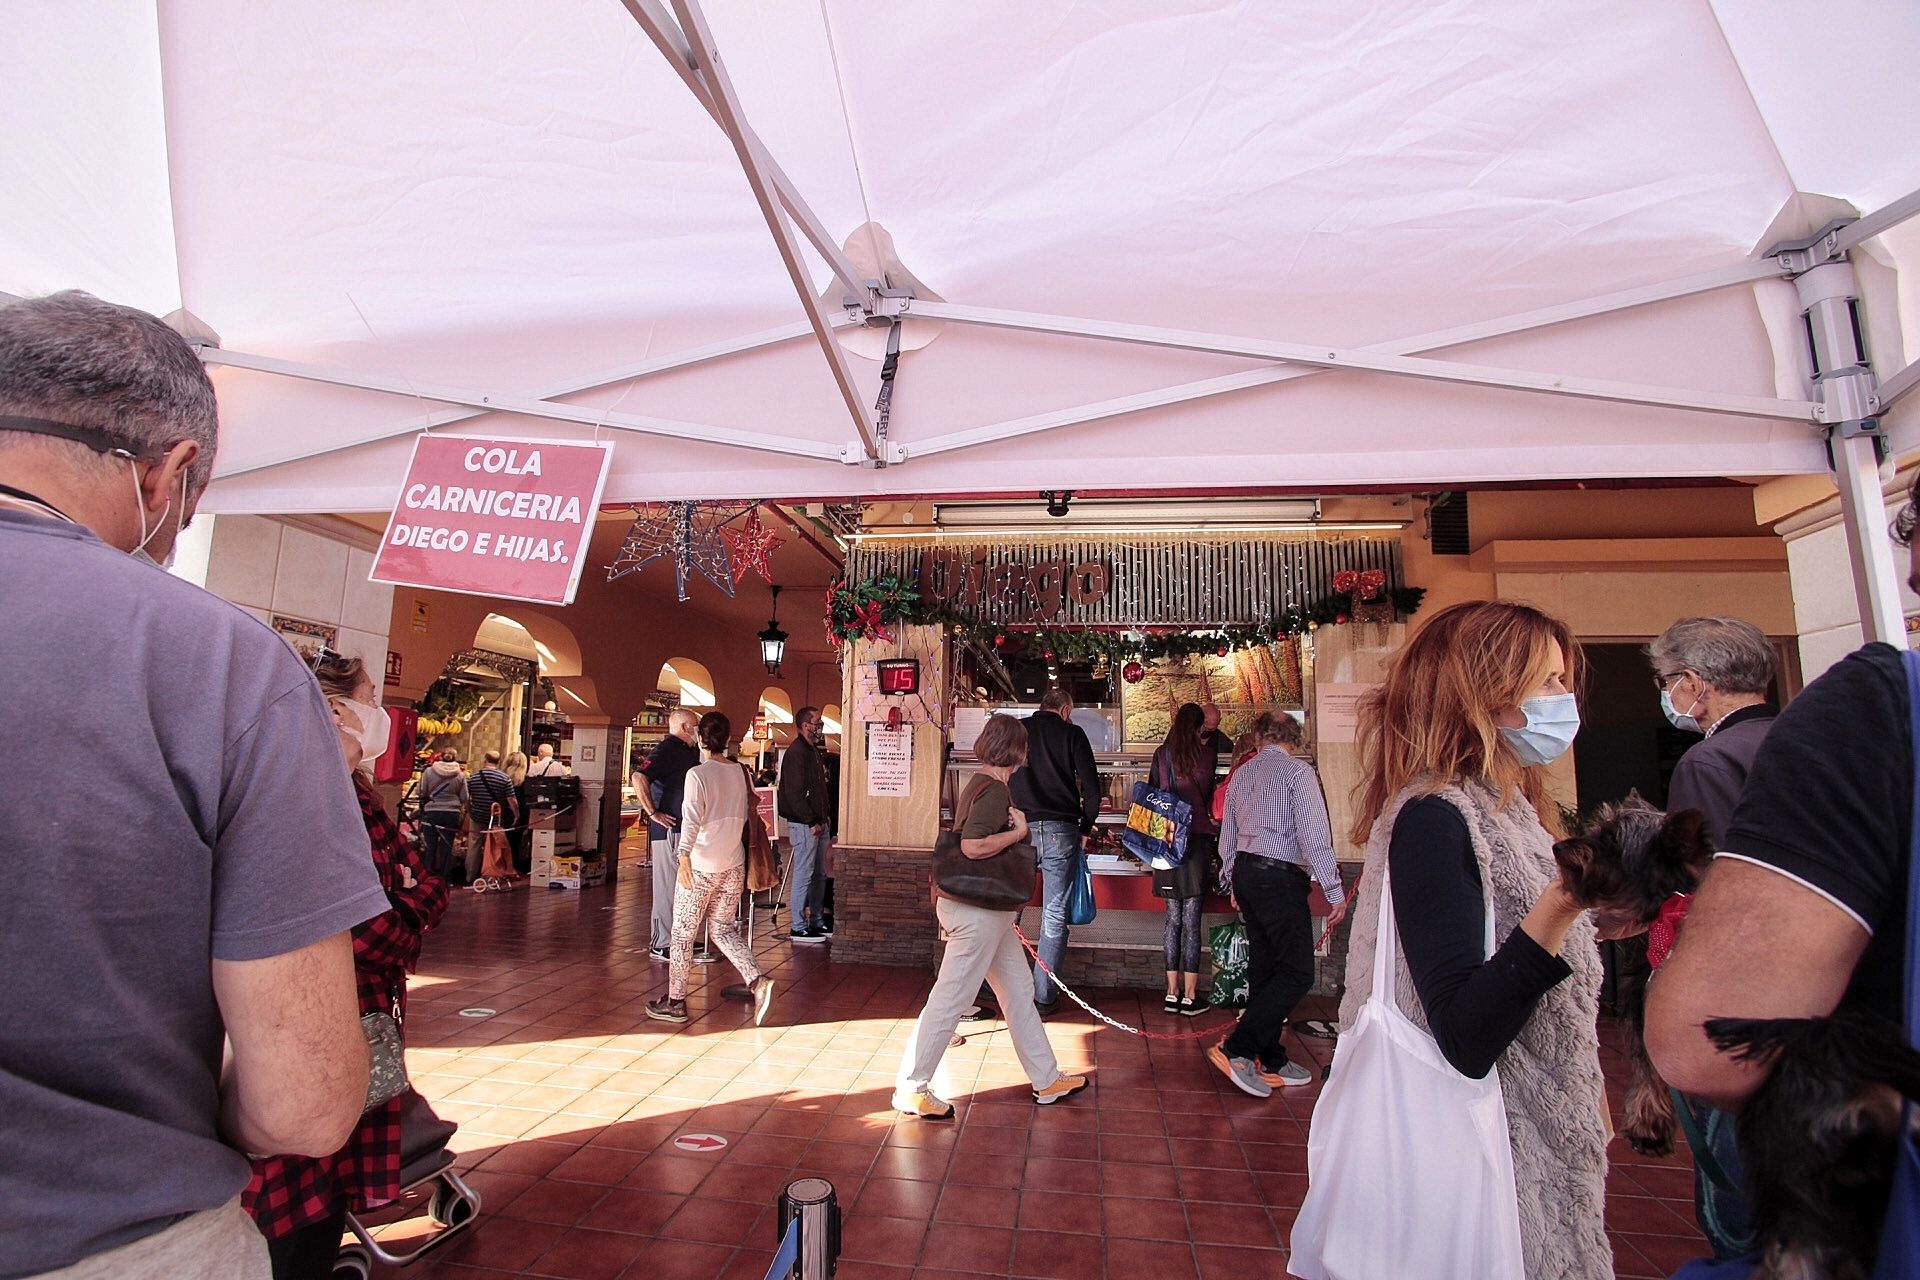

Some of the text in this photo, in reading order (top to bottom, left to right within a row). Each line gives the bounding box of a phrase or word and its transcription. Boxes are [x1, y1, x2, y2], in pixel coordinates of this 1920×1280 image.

[464, 446, 542, 476] COLA
[405, 483, 581, 523] CARNICERIA
[390, 524, 569, 564] DIEGO E HIJAS.
[920, 547, 1108, 622] Diego
[893, 669, 913, 689] 15
